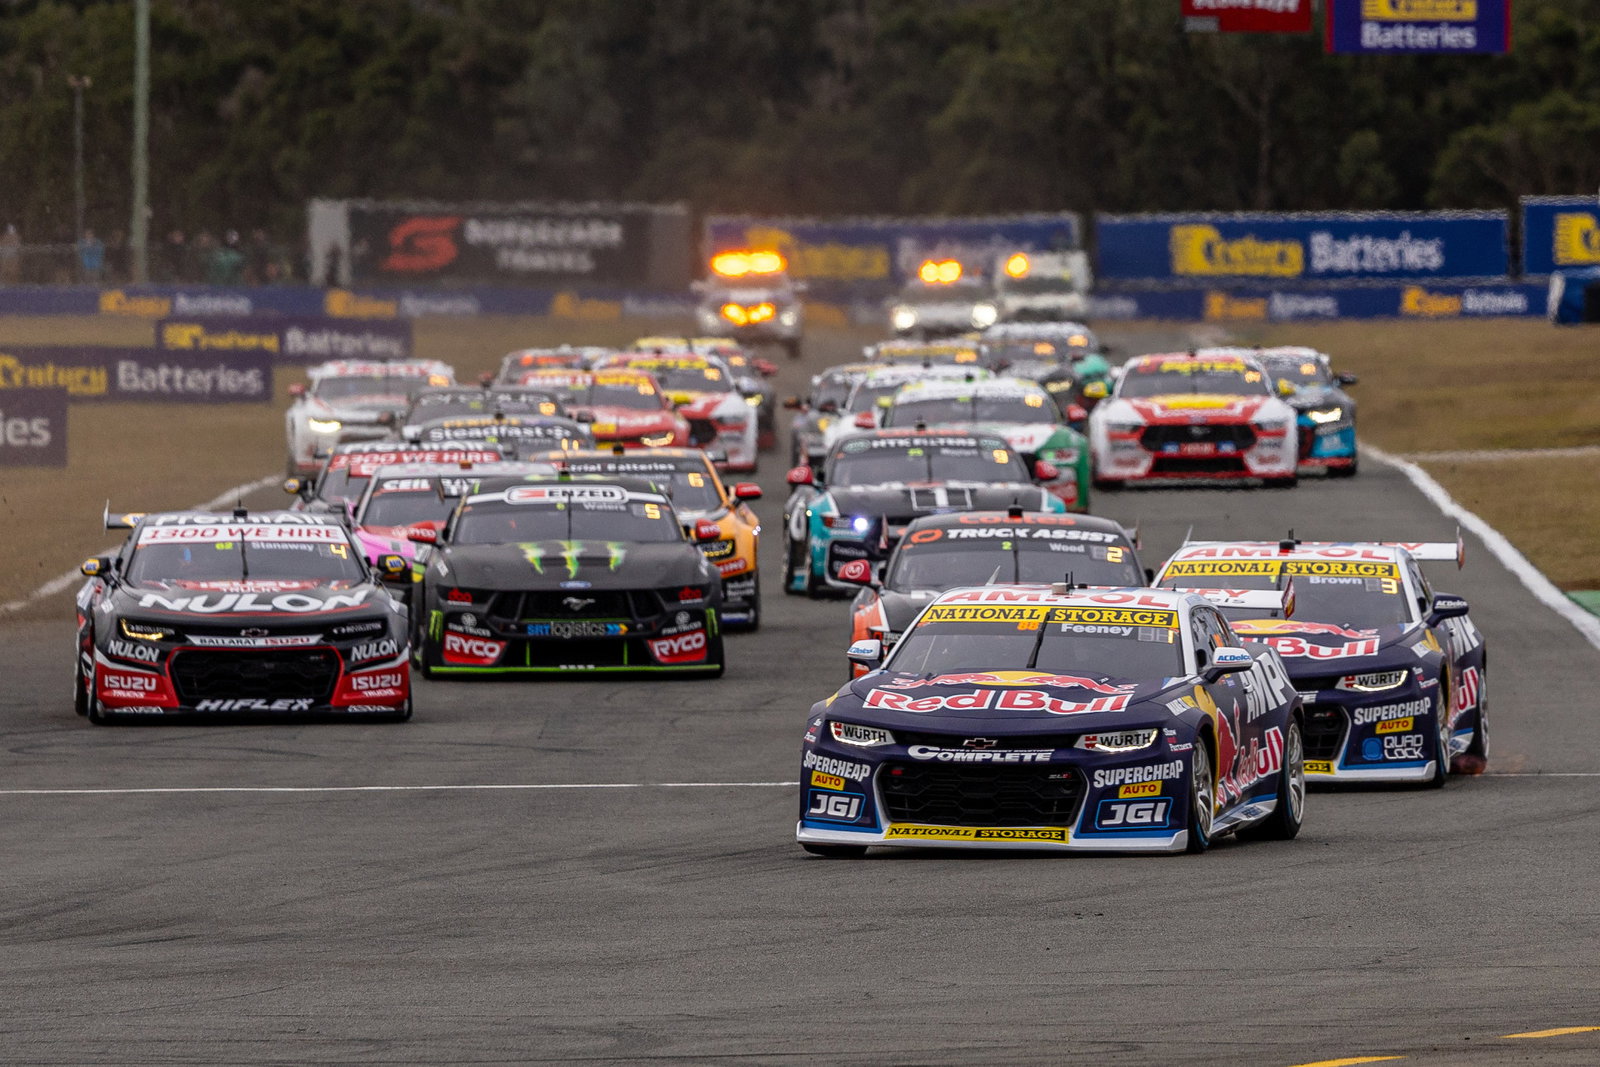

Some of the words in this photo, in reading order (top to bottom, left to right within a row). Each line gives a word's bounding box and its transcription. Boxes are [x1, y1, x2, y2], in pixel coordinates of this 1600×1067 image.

[1361, 22, 1476, 48] Batteries
[1309, 231, 1444, 270] Batteries
[118, 359, 262, 394] Batteries
[430, 425, 549, 441] Steadfast
[333, 454, 398, 469] 1300
[401, 452, 439, 463] WE
[442, 451, 496, 463] HIRE
[992, 449, 1009, 464] 9
[607, 463, 676, 472] Batteries
[687, 472, 704, 488] 6
[548, 489, 615, 498] ENZED
[644, 503, 661, 520] 5
[145, 527, 219, 541] 1300
[227, 527, 270, 538] WE
[277, 527, 342, 540] HIRE
[947, 527, 1031, 540] TRUCK
[1032, 529, 1119, 543] ASSIST
[251, 541, 314, 552] Stanaway
[329, 543, 347, 560] 4
[1002, 541, 1012, 550] 2
[1049, 542, 1085, 553] Wood
[1106, 546, 1123, 563] 2
[1170, 562, 1275, 575] NATIONAL
[1286, 562, 1390, 577] STORAGE
[1309, 576, 1363, 585] Brown
[1380, 577, 1398, 594] 3
[139, 591, 369, 612] NULON
[928, 608, 1040, 620] NATIONAL
[1054, 609, 1169, 625] STORAGE
[1017, 621, 1040, 631] 88
[1060, 623, 1134, 637] Feeney
[199, 638, 257, 647] BALLARAT
[264, 637, 311, 646] ISUZU
[351, 638, 398, 662] NULON
[445, 634, 501, 658] RYCO
[654, 632, 705, 656] RYCO
[1263, 637, 1380, 659] Bull
[108, 640, 160, 663] NULON
[104, 674, 157, 691] ISUZU
[351, 673, 402, 691] ISUZU
[1357, 671, 1402, 687] WÜRTH
[196, 698, 315, 711] HIFLEX
[863, 688, 997, 712] Red
[996, 690, 1134, 714] Bull
[1354, 697, 1431, 725] SUPERCHEAP
[843, 725, 887, 743] WÜRTH
[1379, 720, 1409, 731] AUTO
[1100, 732, 1151, 746] WÜRTH
[1384, 734, 1424, 749] QUAD
[908, 744, 1053, 762] COMPLETE
[1384, 747, 1424, 760] LOCK
[803, 750, 872, 782] SUPERCHEAP
[1093, 760, 1184, 788] SUPERCHEAP
[814, 774, 841, 787] AUTO
[1123, 784, 1157, 795] AUTO
[809, 794, 860, 818] JGI
[1102, 802, 1167, 825] JGI
[889, 827, 974, 837] NATIONAL
[979, 829, 1062, 840] STORAGE
